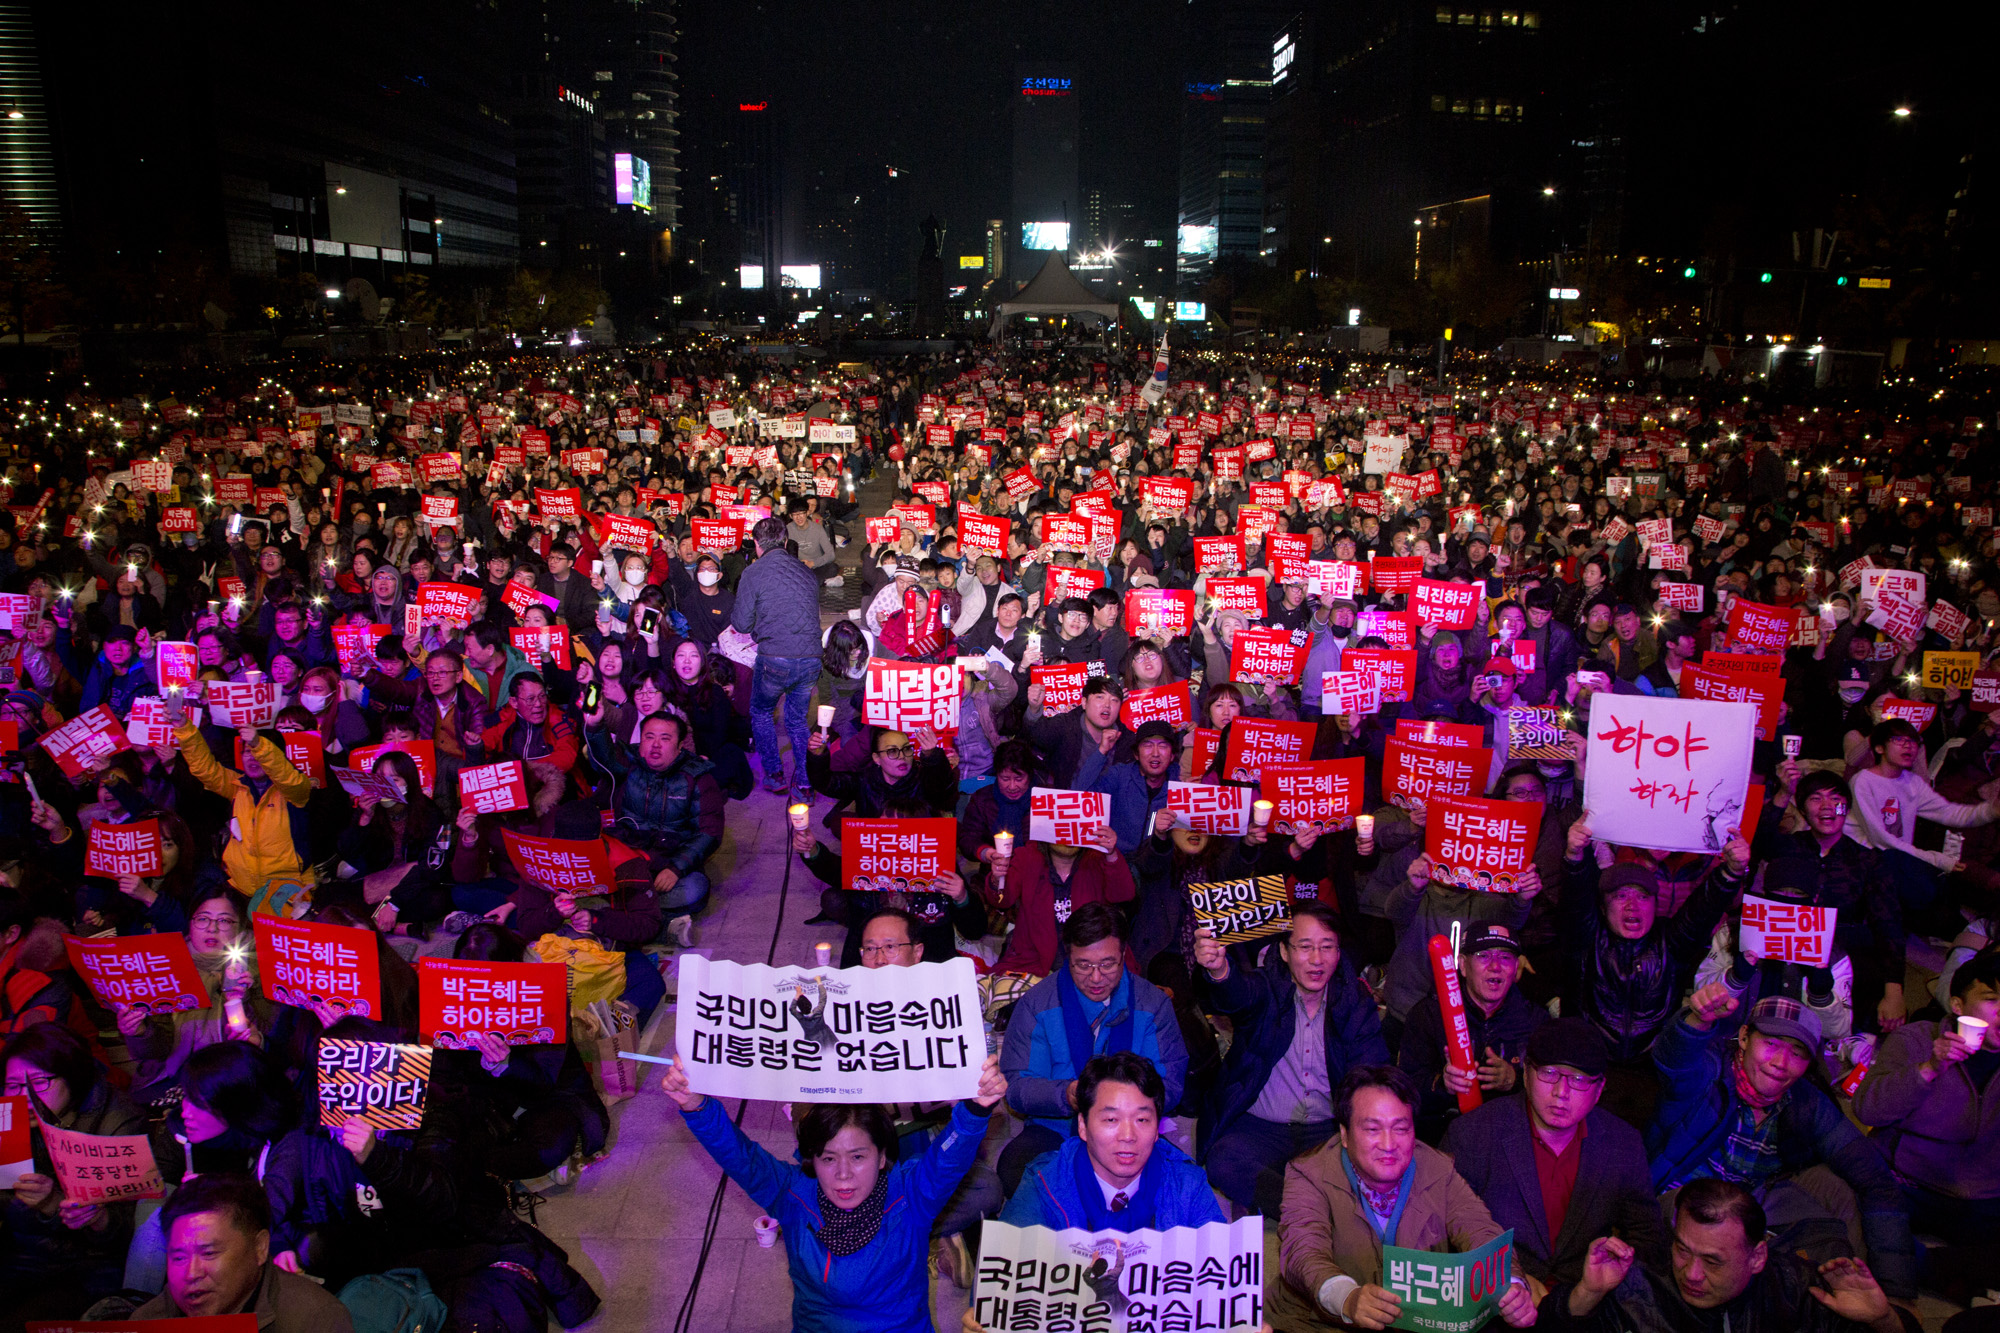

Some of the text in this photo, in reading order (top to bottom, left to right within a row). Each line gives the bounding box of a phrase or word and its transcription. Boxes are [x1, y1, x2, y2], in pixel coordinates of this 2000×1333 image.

[1021, 77, 1072, 89] 조선일보
[572, 461, 601, 472] 박근혜
[1004, 473, 1029, 489] 박근혜는
[1635, 476, 1660, 485] 박근혜
[540, 494, 573, 506] 박근혜는
[1154, 486, 1187, 498] 박근혜는
[1255, 488, 1284, 498] 박근혜는
[1637, 485, 1658, 496] 퇴진
[541, 504, 575, 516] 하야하라
[1154, 495, 1187, 507] 하야하라
[1254, 496, 1285, 505] 하야하라
[165, 518, 195, 529] OUT!
[167, 509, 192, 519] 박근혜
[1050, 516, 1085, 530] 박근혜는
[1695, 515, 1724, 531] 박근혜
[611, 521, 648, 536] 박근혜는
[700, 525, 736, 537] 박근혜는
[965, 522, 1001, 536] 박근혜는
[1637, 520, 1669, 533] 박근혜
[609, 532, 647, 546] 하야하라
[700, 536, 736, 546] 하야하라
[963, 532, 1000, 548] 하야하라
[1049, 530, 1085, 545] 하야하라
[1274, 539, 1307, 551] 박근혜는
[1647, 530, 1670, 543] 퇴진
[1201, 542, 1237, 554] 박근혜는
[1652, 544, 1685, 558] 박근혜
[1308, 564, 1351, 580] 박근혜
[1661, 557, 1685, 571] 퇴진
[1215, 584, 1256, 597] 박근혜는
[1320, 580, 1351, 597] 퇴진
[1659, 583, 1699, 599] 박근혜
[1870, 575, 1917, 592] 박근혜
[425, 590, 469, 605] 박근혜는
[1140, 598, 1185, 612] 박근혜는
[1216, 597, 1257, 610] 하야하라
[1416, 586, 1473, 607] 퇴진하라
[1671, 597, 1699, 612] 퇴진
[423, 603, 466, 618] 하야하라
[1417, 604, 1465, 624] 박근혜!
[1880, 597, 1925, 627] 박근혜
[1933, 600, 1966, 629] 박근혜
[12, 612, 39, 630] 퇴진
[408, 608, 418, 634] 하야
[1742, 611, 1789, 632] 박근혜는
[1291, 637, 1306, 647] 하라
[1292, 628, 1308, 638] 하야
[1738, 627, 1786, 647] 하야하라
[163, 652, 196, 665] 박근혜
[1244, 640, 1295, 658] 박근혜는
[1087, 660, 1105, 670] 하야
[1088, 668, 1105, 678] 하라
[1242, 656, 1293, 674] 하야하라
[1353, 658, 1405, 675] 박근혜는
[1745, 660, 1761, 673] 7대
[1762, 660, 1778, 674] 요구
[866, 664, 960, 702] 내려와
[1322, 671, 1376, 696] 박근혜
[1929, 667, 1973, 688] 하야!
[207, 683, 276, 709] 박근혜
[1694, 677, 1765, 706] 박근혜는
[1129, 693, 1181, 714] 박근혜는
[1339, 692, 1374, 715] 퇴진
[230, 706, 272, 730] 퇴진
[866, 699, 960, 733] 박근혜
[1510, 708, 1556, 727] 우리가
[42, 706, 112, 757] 재벌도
[1244, 730, 1302, 751] 박근혜는
[1597, 715, 1710, 771] 하야
[1399, 752, 1473, 780] 박근혜는
[460, 761, 518, 794] 재벌도
[1277, 774, 1350, 797] 박근혜는
[474, 786, 516, 814] 공범
[1031, 792, 1105, 820] 박근혜
[1168, 787, 1242, 813] 박근혜
[1278, 795, 1350, 819] 하야하라
[1189, 813, 1240, 835] 퇴진
[1444, 811, 1527, 843] 박근혜는
[90, 827, 155, 851] 박근혜는
[860, 833, 938, 854] 박근혜는
[90, 850, 157, 875] 퇴진하라
[518, 845, 590, 869] 박근혜는
[1440, 839, 1525, 870] 하야하라
[526, 863, 596, 887] 하야하라
[859, 856, 939, 877] 하야하라
[1191, 879, 1257, 913] 이것이
[1294, 882, 1318, 892] 하야
[1294, 891, 1318, 900] 하라
[1197, 900, 1285, 938] 국가인가
[1742, 903, 1826, 932] 박근혜
[271, 934, 358, 967] 박근혜는
[1764, 935, 1822, 962] 퇴진
[82, 951, 171, 976] 박근혜는
[92, 974, 181, 1000] 하야하라
[274, 961, 360, 996] 하야하라
[442, 977, 544, 1003] 박근혜는
[442, 1006, 545, 1028] 하야하라
[696, 990, 963, 1035] 국민의 마음속에
[1441, 954, 1471, 1065] 박근혜 퇴진!
[318, 1044, 398, 1074] 우리가
[691, 1029, 969, 1073] 대통령은 없습니다
[617, 1060, 627, 1093] BURGER
[318, 1078, 422, 1111] 주인이다
[799, 1086, 863, 1095] 더불어민주당 전북도당
[60, 1141, 137, 1158] 사이비교주
[76, 1164, 140, 1180] 조종당한
[979, 1252, 1260, 1297] 국민의 마음속에
[1390, 1244, 1509, 1307] 박근혜 OUT
[975, 1293, 1262, 1333] 대통령은 없습니다
